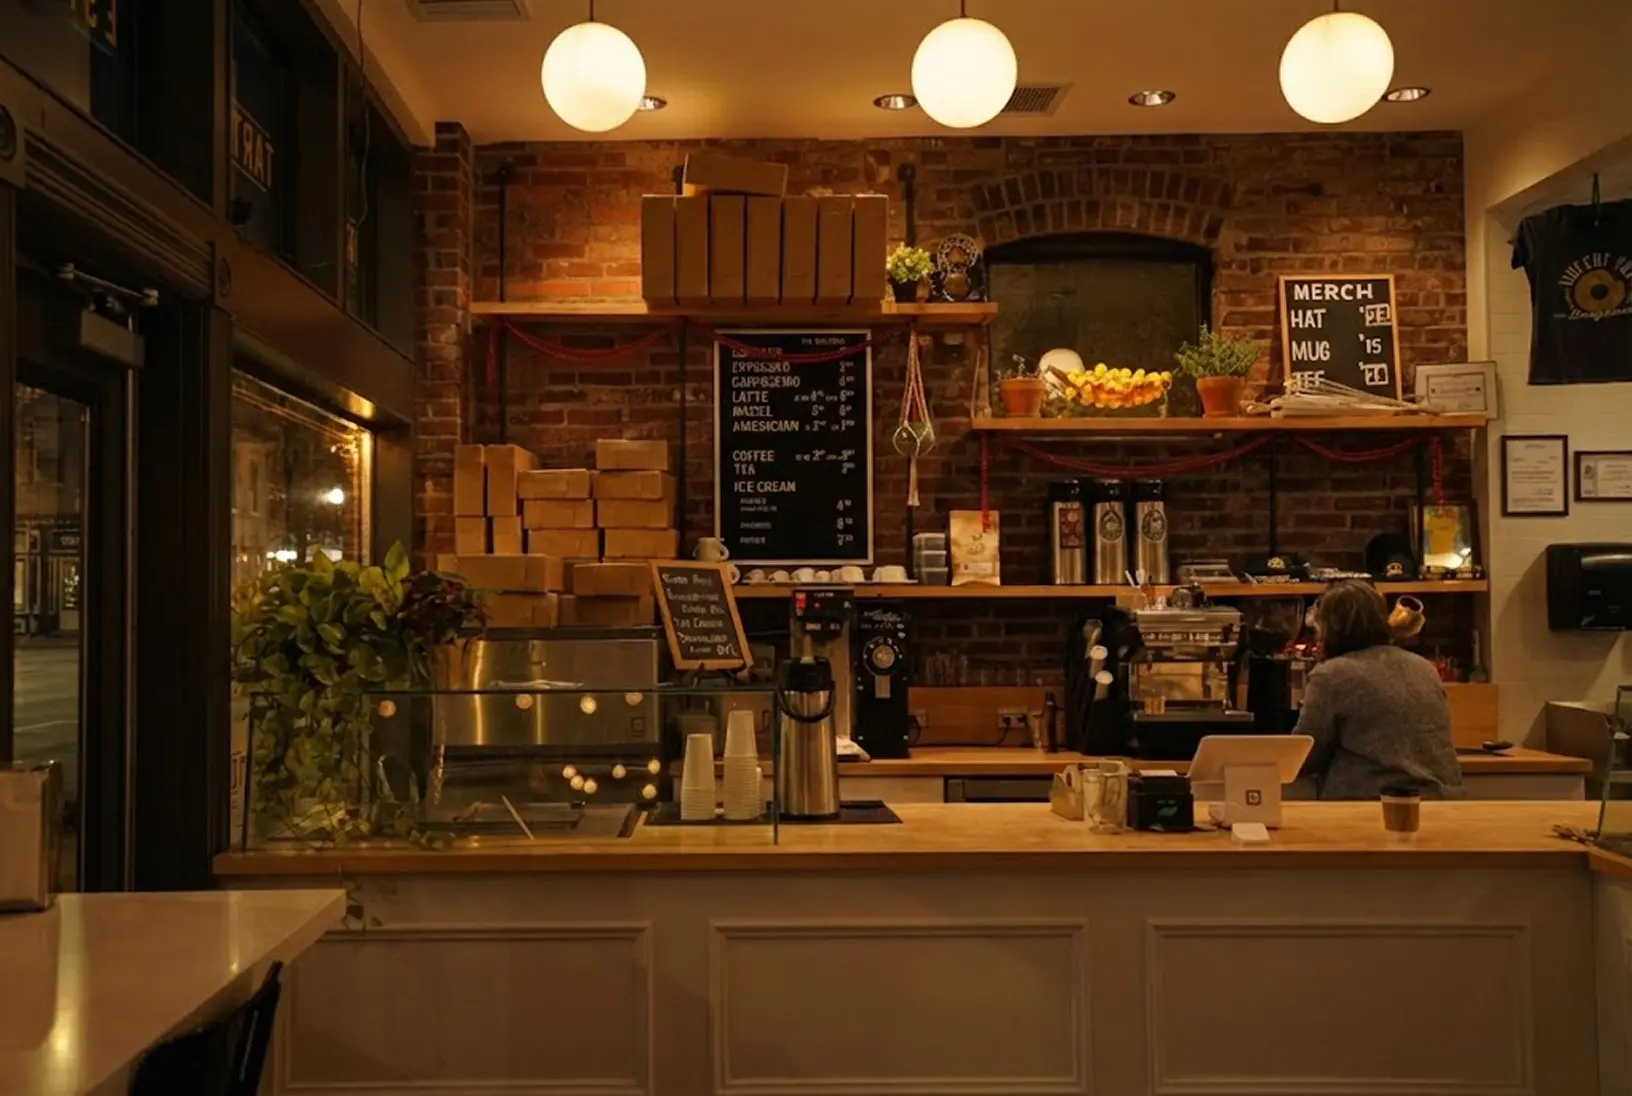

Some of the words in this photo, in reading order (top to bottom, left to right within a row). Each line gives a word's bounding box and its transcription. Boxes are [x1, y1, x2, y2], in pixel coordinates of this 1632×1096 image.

[1294, 283, 1374, 301] MERCH
[1290, 308, 1327, 329] HAT
[1292, 340, 1331, 361] MUG
[732, 390, 769, 403] LATTE
[732, 450, 775, 462] COFFEE
[734, 481, 754, 493] ICE
